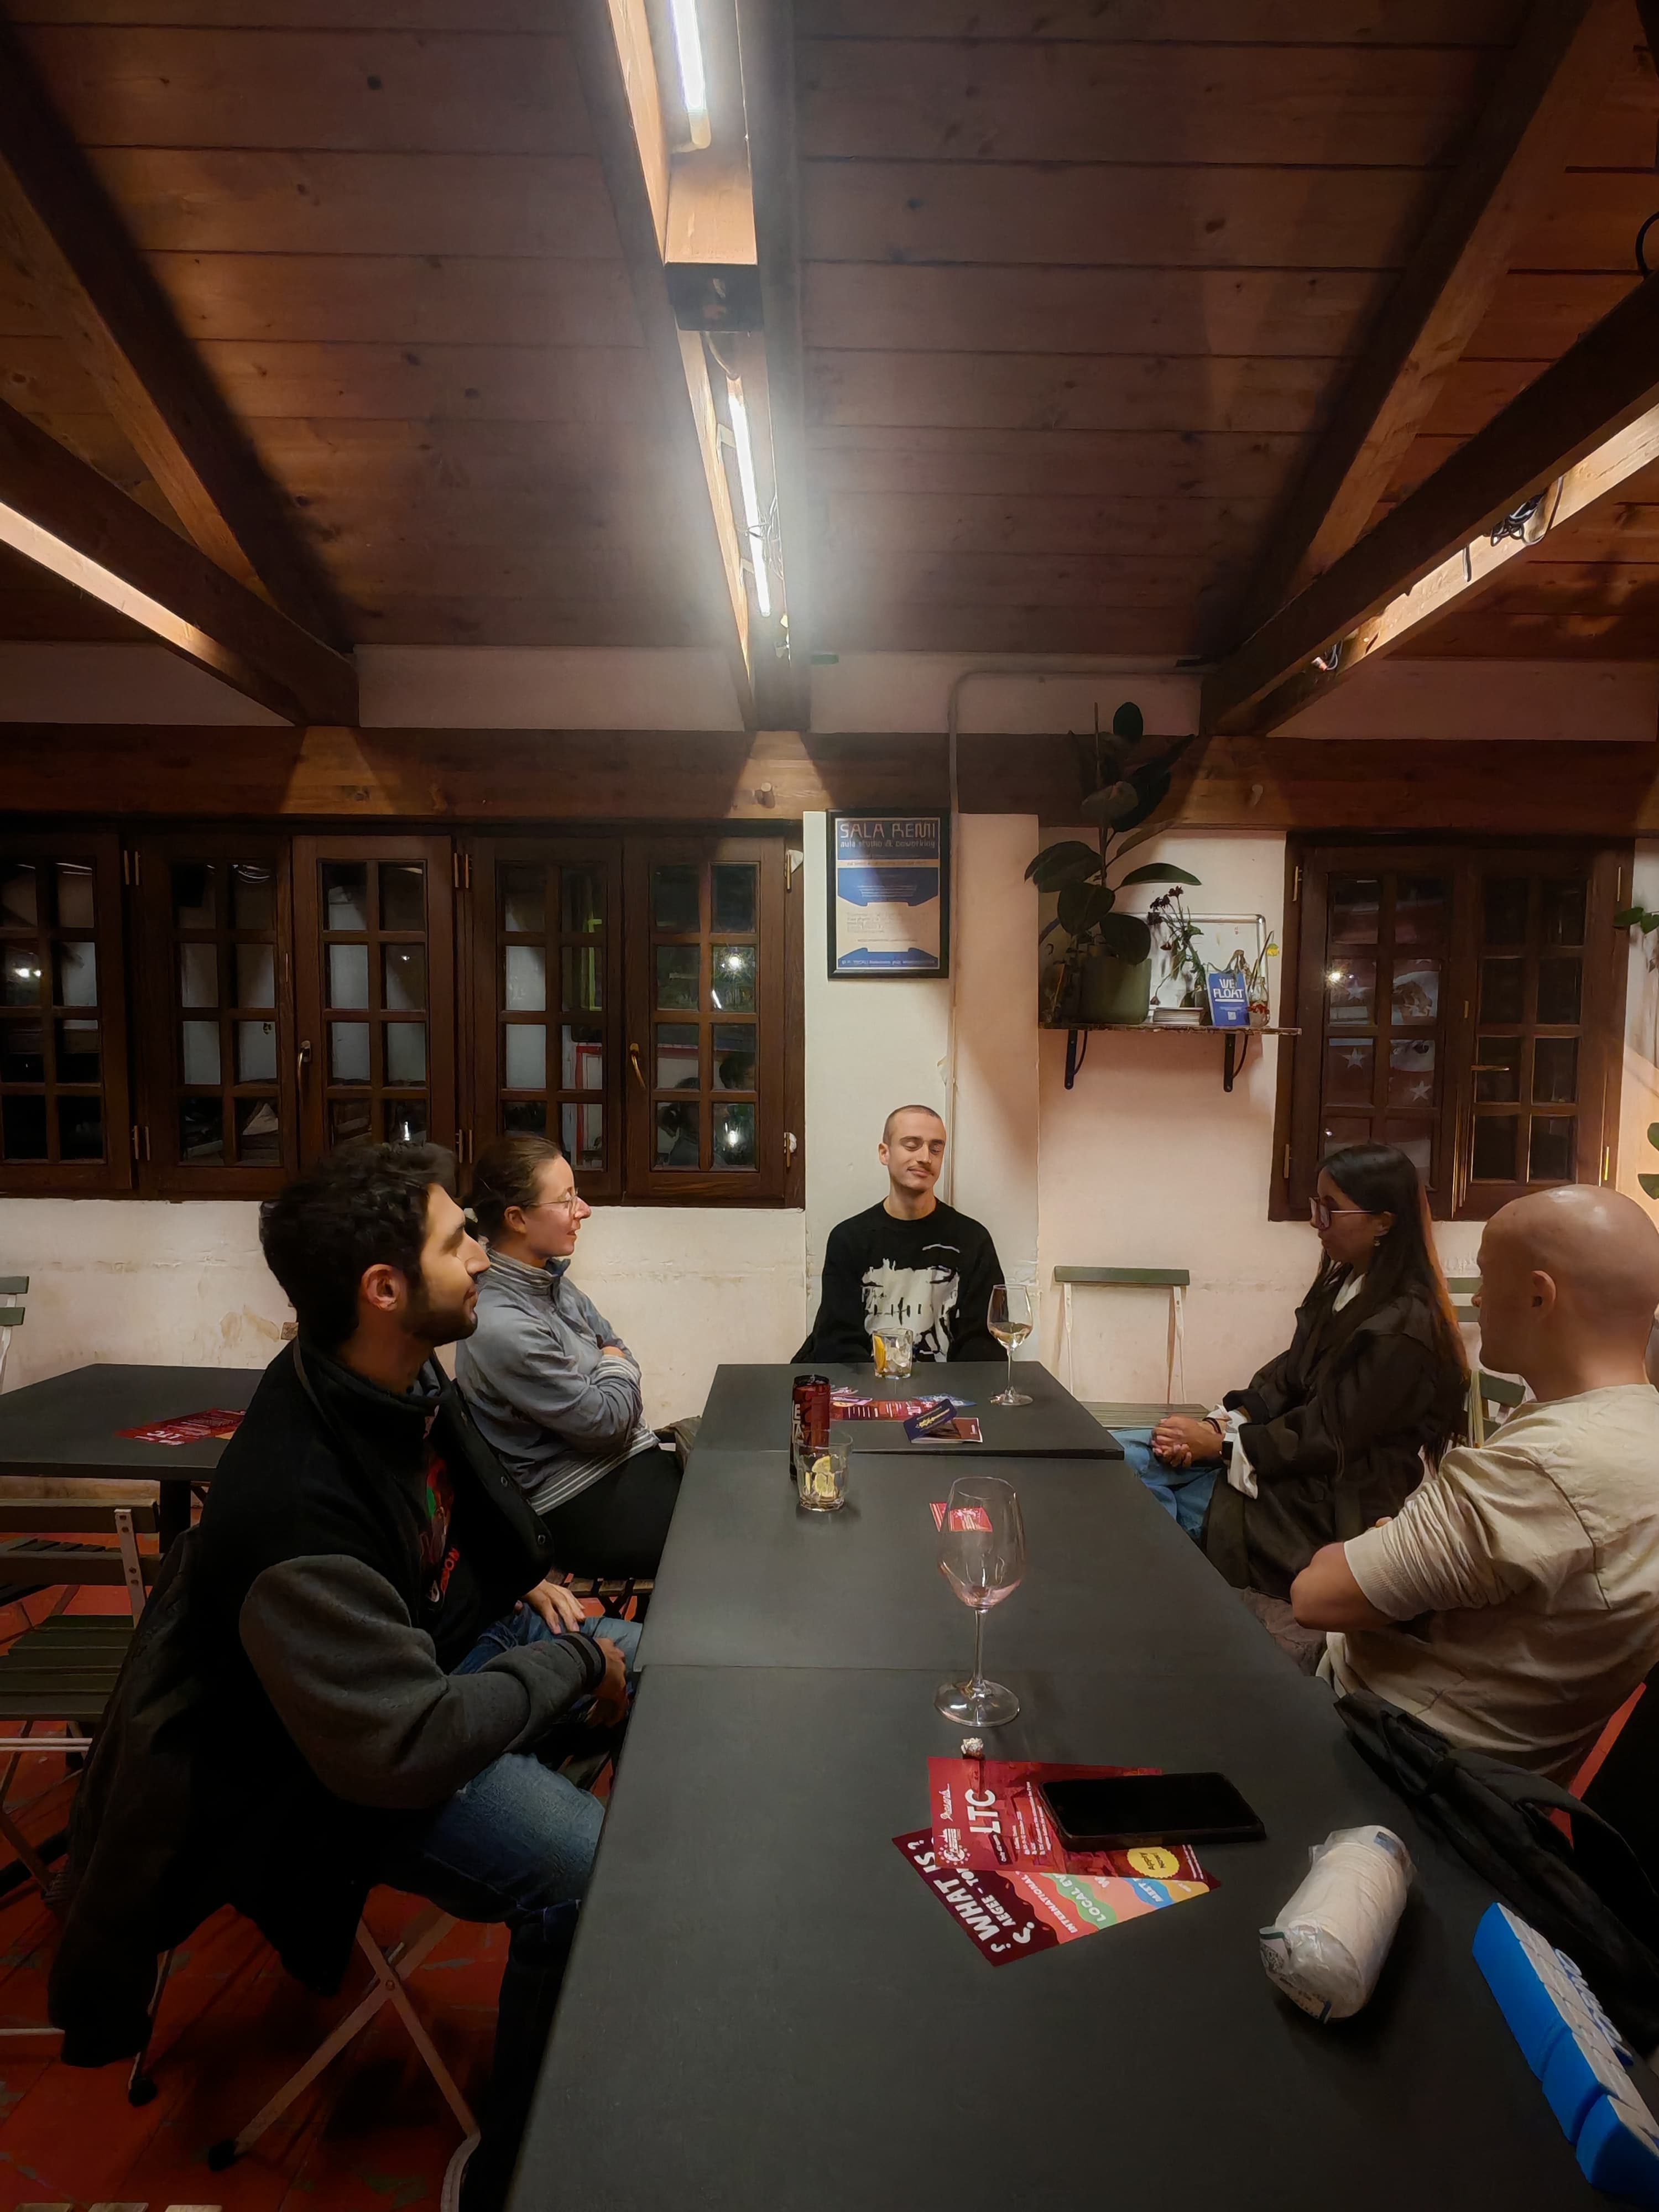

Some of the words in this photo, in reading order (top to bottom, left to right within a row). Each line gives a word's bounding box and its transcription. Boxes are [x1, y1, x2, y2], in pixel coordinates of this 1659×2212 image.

[840, 822, 884, 838] SALA
[1213, 988, 1244, 998] FLOAT
[1219, 979, 1235, 989] WE
[965, 1788, 1001, 1834] LTC
[914, 1852, 939, 1873] IS
[933, 1879, 1000, 1941] WHAT
[981, 1895, 1016, 1926] AEGEE
[1021, 1875, 1078, 1933] INTERNATIONAL
[1071, 1887, 1106, 1922] LOCAL
